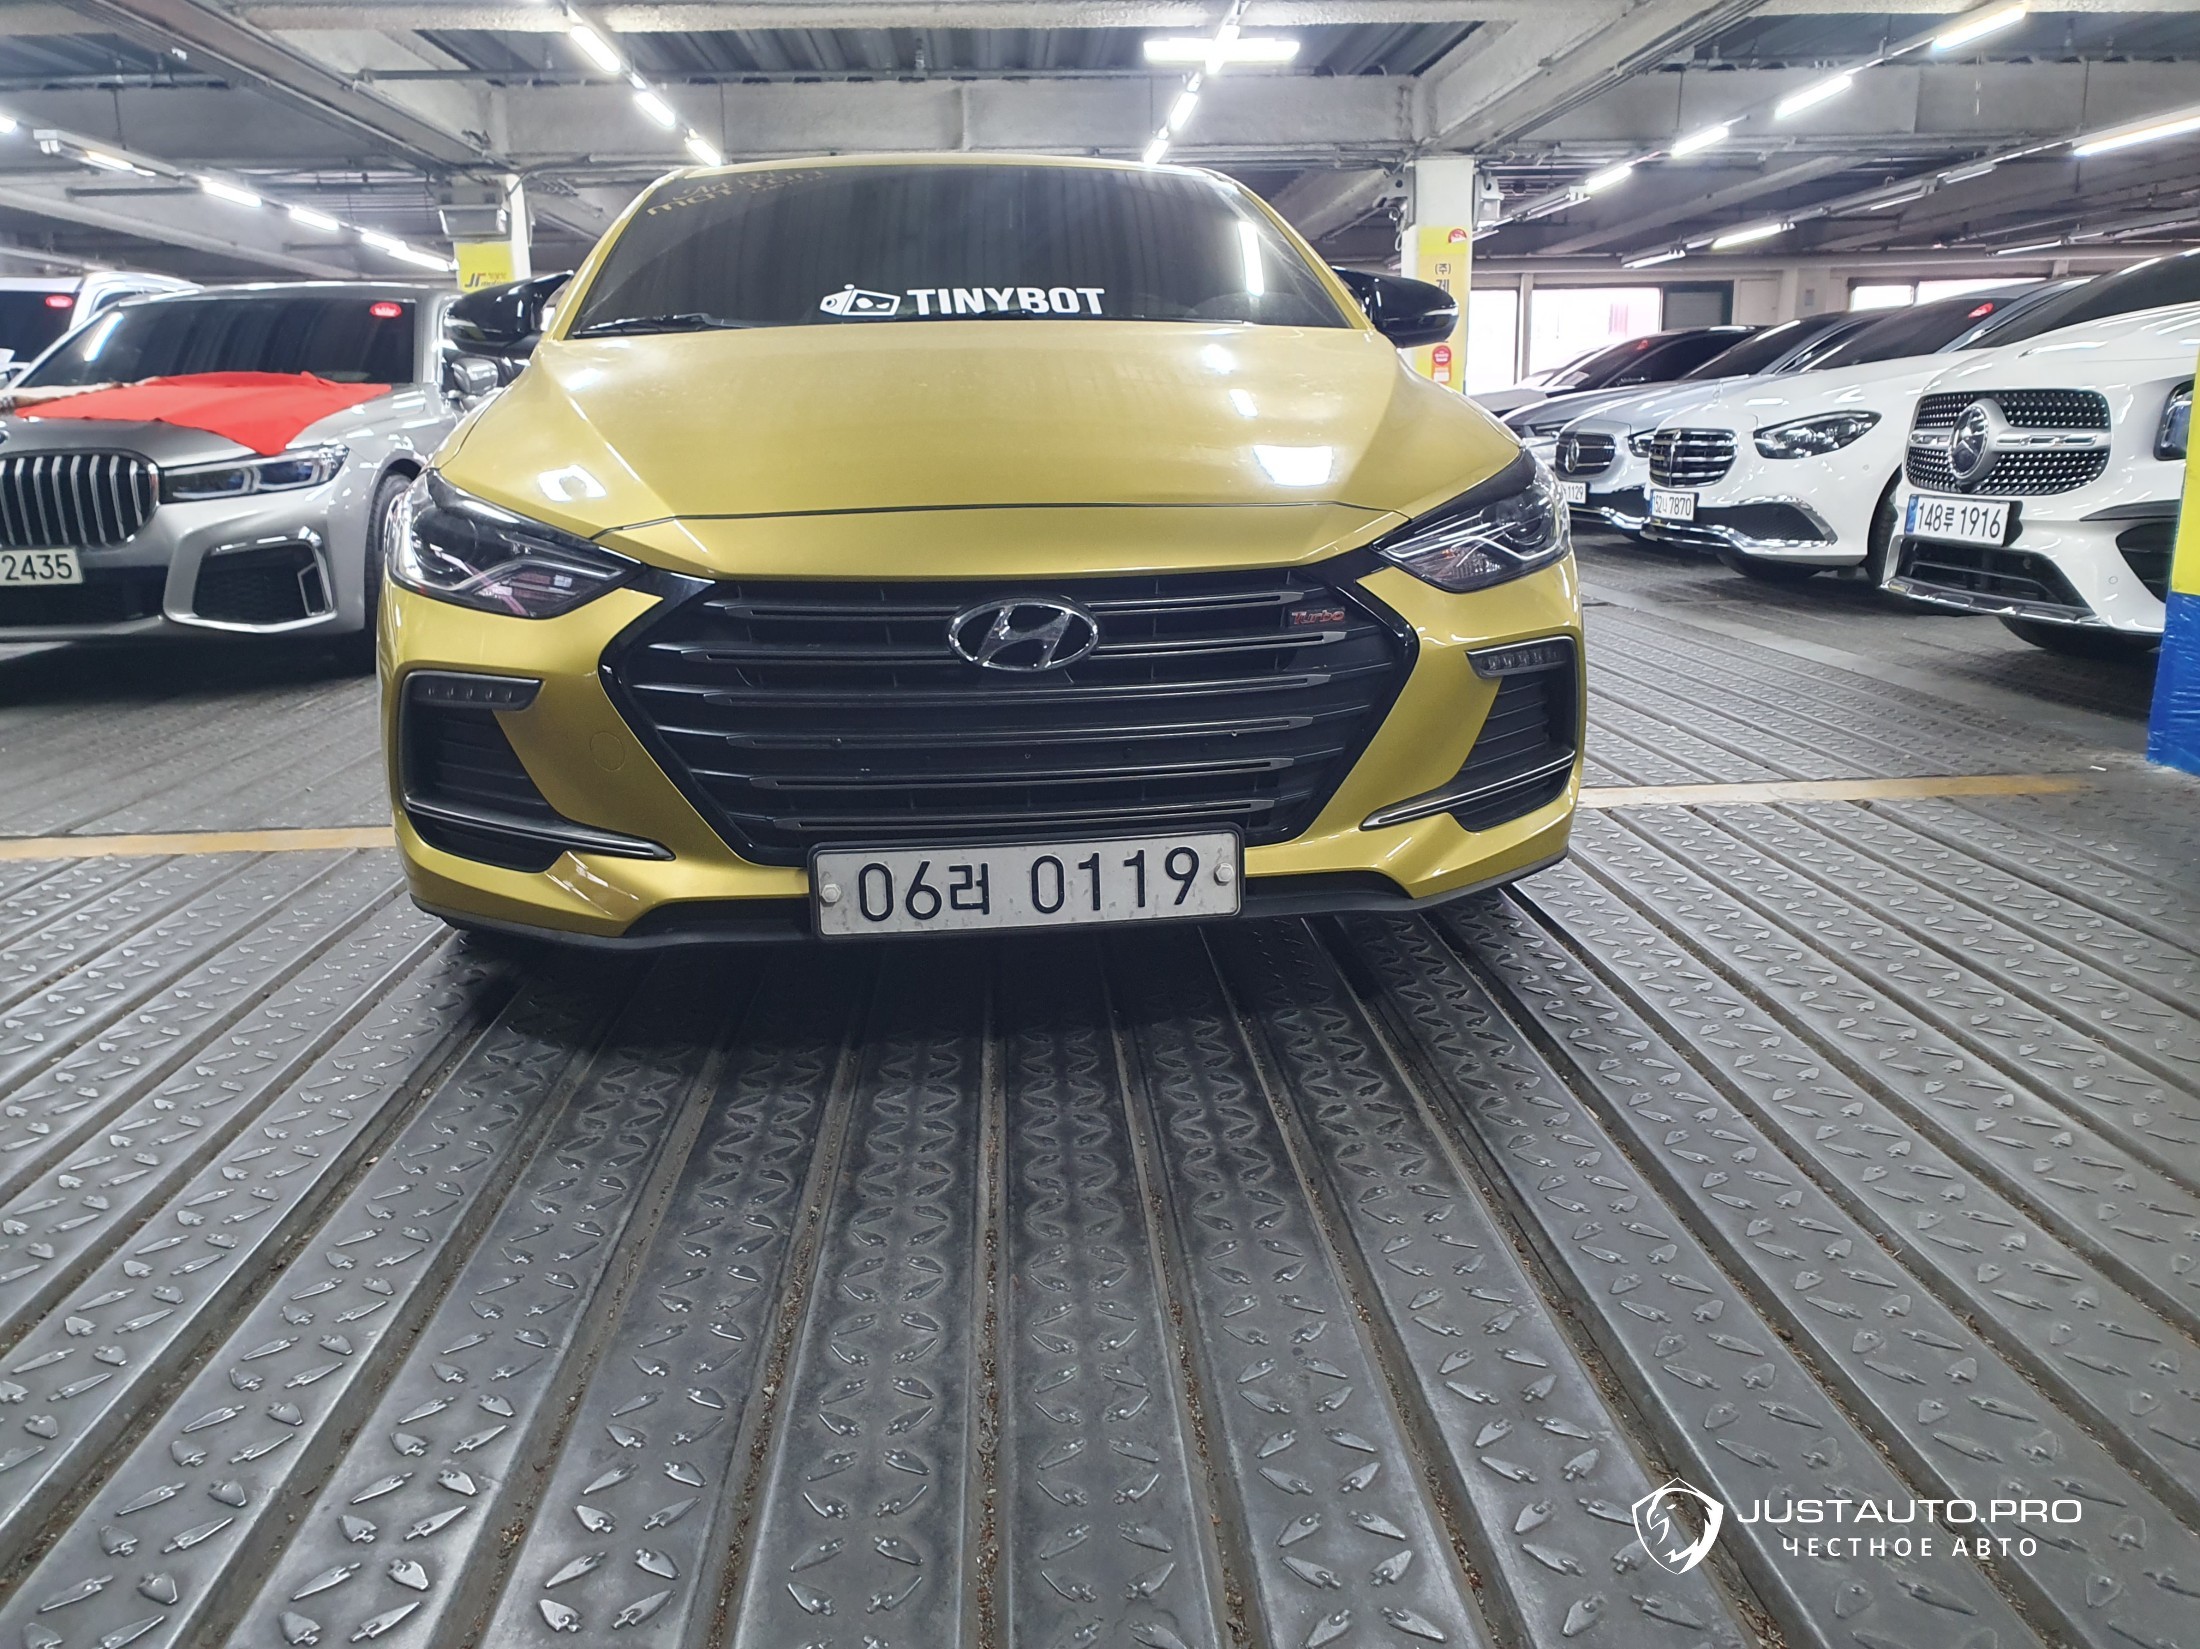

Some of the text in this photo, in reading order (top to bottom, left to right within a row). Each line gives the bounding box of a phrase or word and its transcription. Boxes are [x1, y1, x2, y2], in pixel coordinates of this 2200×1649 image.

[906, 287, 1106, 316] TINYBOT
[1568, 485, 1584, 500] 1129
[1669, 497, 1692, 516] 7870
[1918, 501, 2001, 539] 148루 1916
[1, 553, 73, 581] 2435
[1291, 608, 1346, 625] Turbo
[857, 846, 1201, 922] 06러 0119
